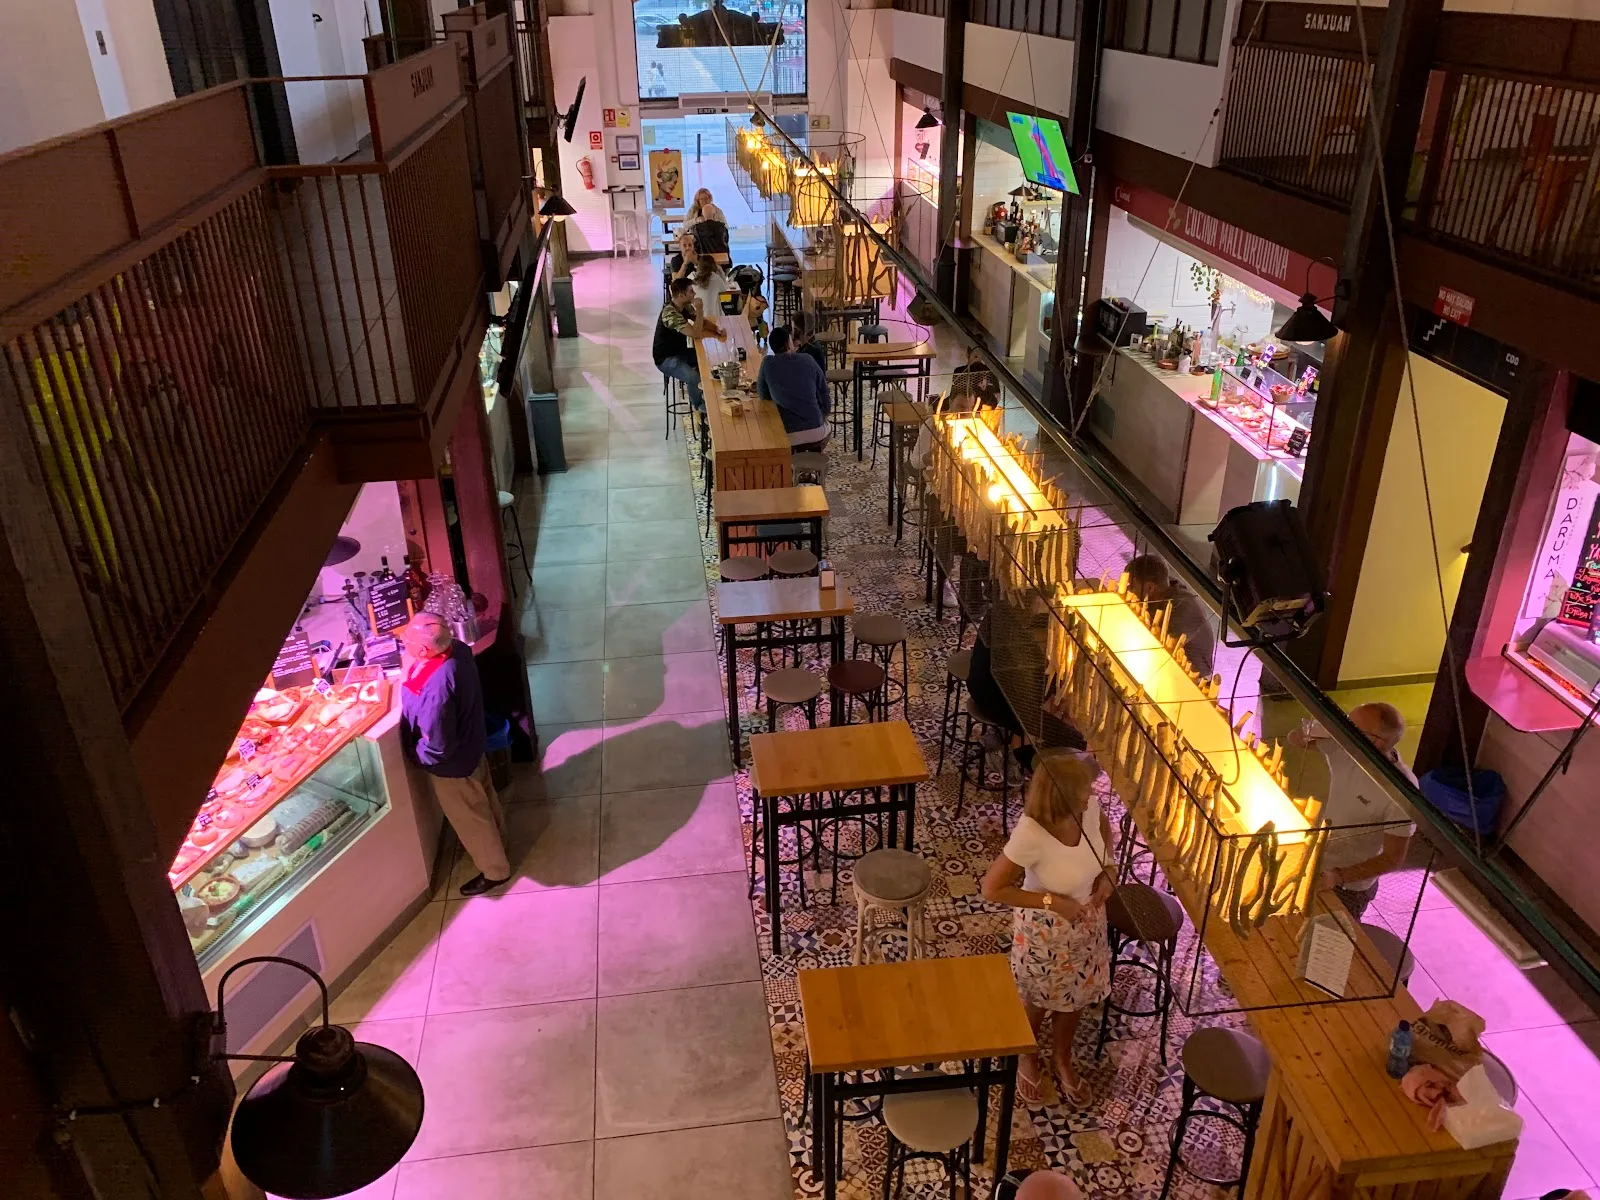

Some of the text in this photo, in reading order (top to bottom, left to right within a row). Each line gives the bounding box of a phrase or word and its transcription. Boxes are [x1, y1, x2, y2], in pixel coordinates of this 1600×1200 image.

[1184, 206, 1290, 281] COCINA MALLORQUINA
[1543, 497, 1578, 580] DARUMA
